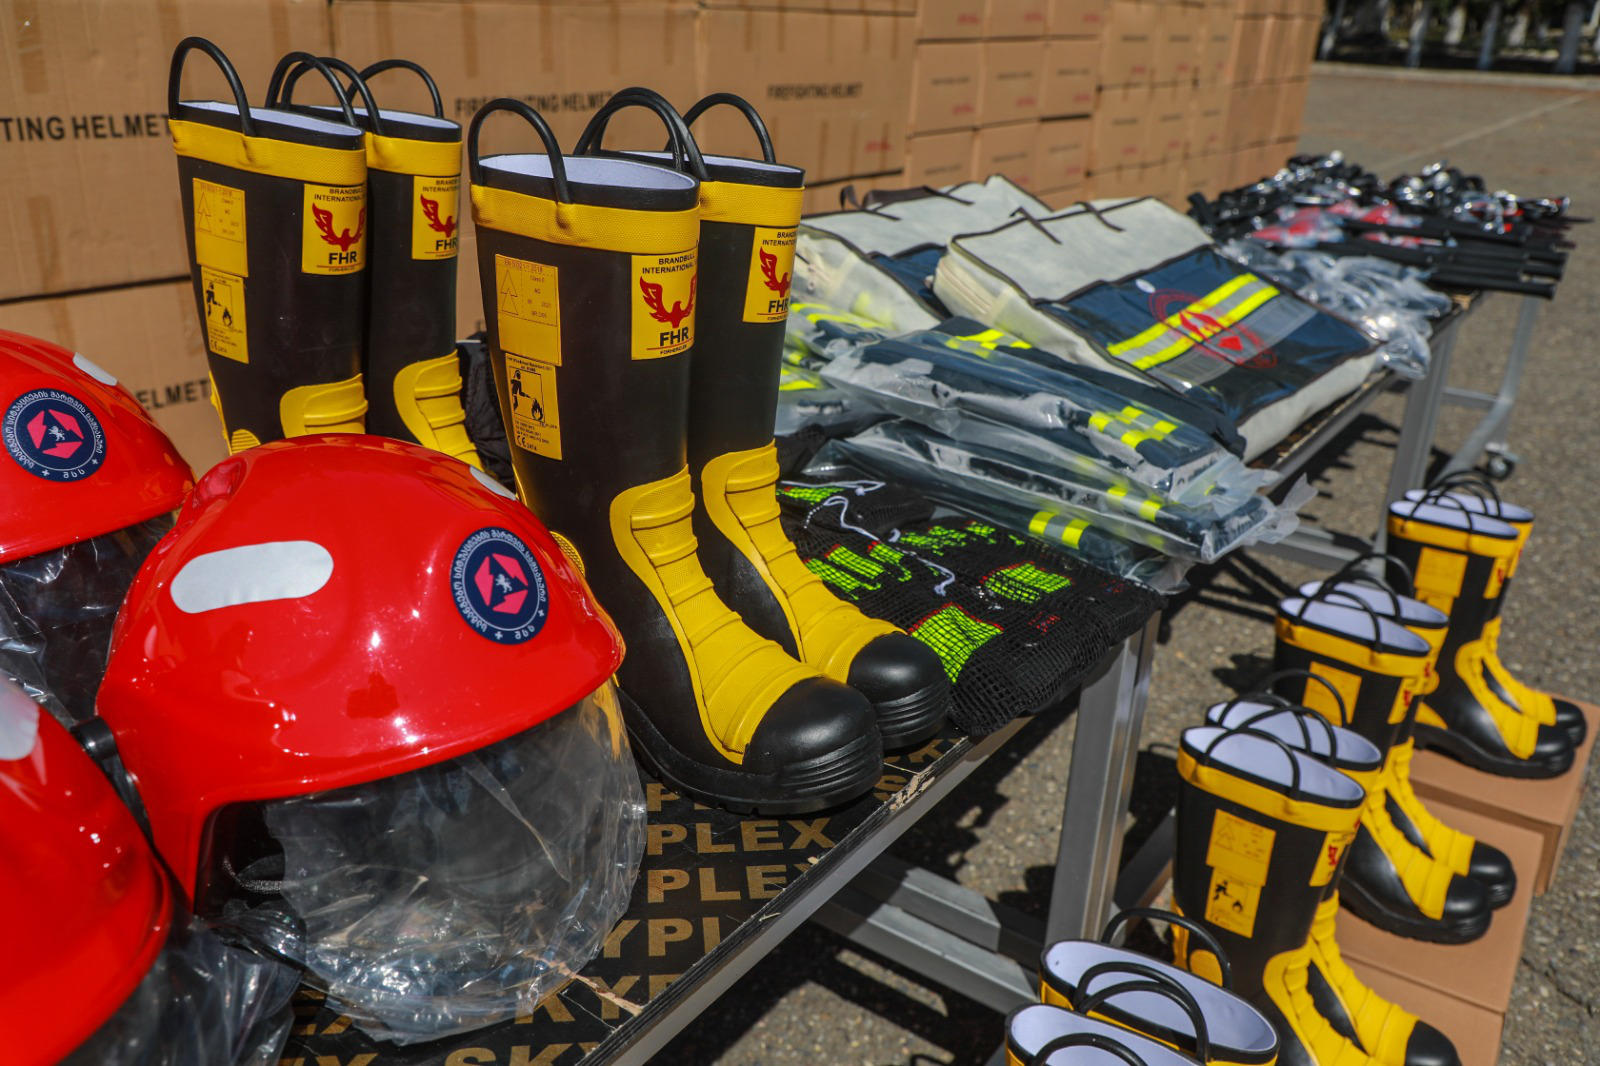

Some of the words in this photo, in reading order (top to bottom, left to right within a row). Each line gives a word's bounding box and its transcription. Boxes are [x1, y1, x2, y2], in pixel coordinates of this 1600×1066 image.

[0, 115, 65, 142] TING
[71, 113, 170, 140] HELMET
[328, 251, 357, 265] FHR
[659, 326, 689, 347] FHR
[647, 863, 816, 903] PLE
